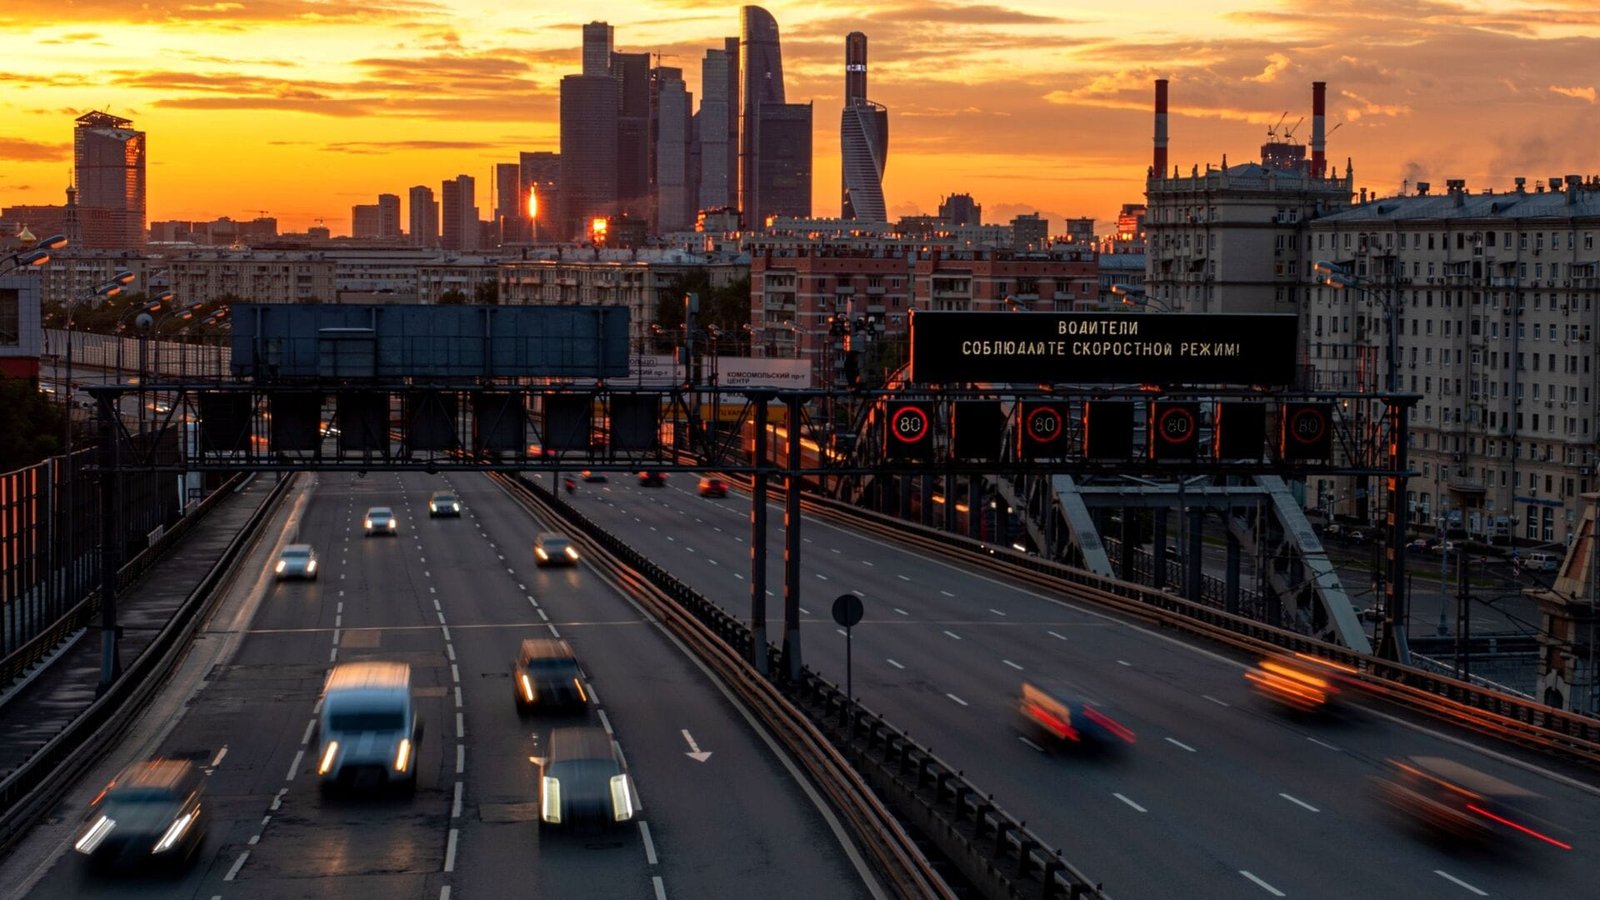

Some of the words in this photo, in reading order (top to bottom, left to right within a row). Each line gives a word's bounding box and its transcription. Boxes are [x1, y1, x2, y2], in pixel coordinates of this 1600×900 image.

[1058, 320, 1139, 336] ВОДИТЕЛИ
[961, 340, 1066, 356] СОБЛЮДАЙТЕ
[1072, 341, 1173, 357] СКОРОСТНОЙ
[1180, 343, 1241, 358] РЕЖИМ!
[727, 371, 790, 380] КОМСОМОЛЬСКИЙ
[900, 416, 921, 432] 80
[1034, 416, 1055, 432] 80
[1167, 416, 1187, 433] 80
[1298, 415, 1319, 433] 80
